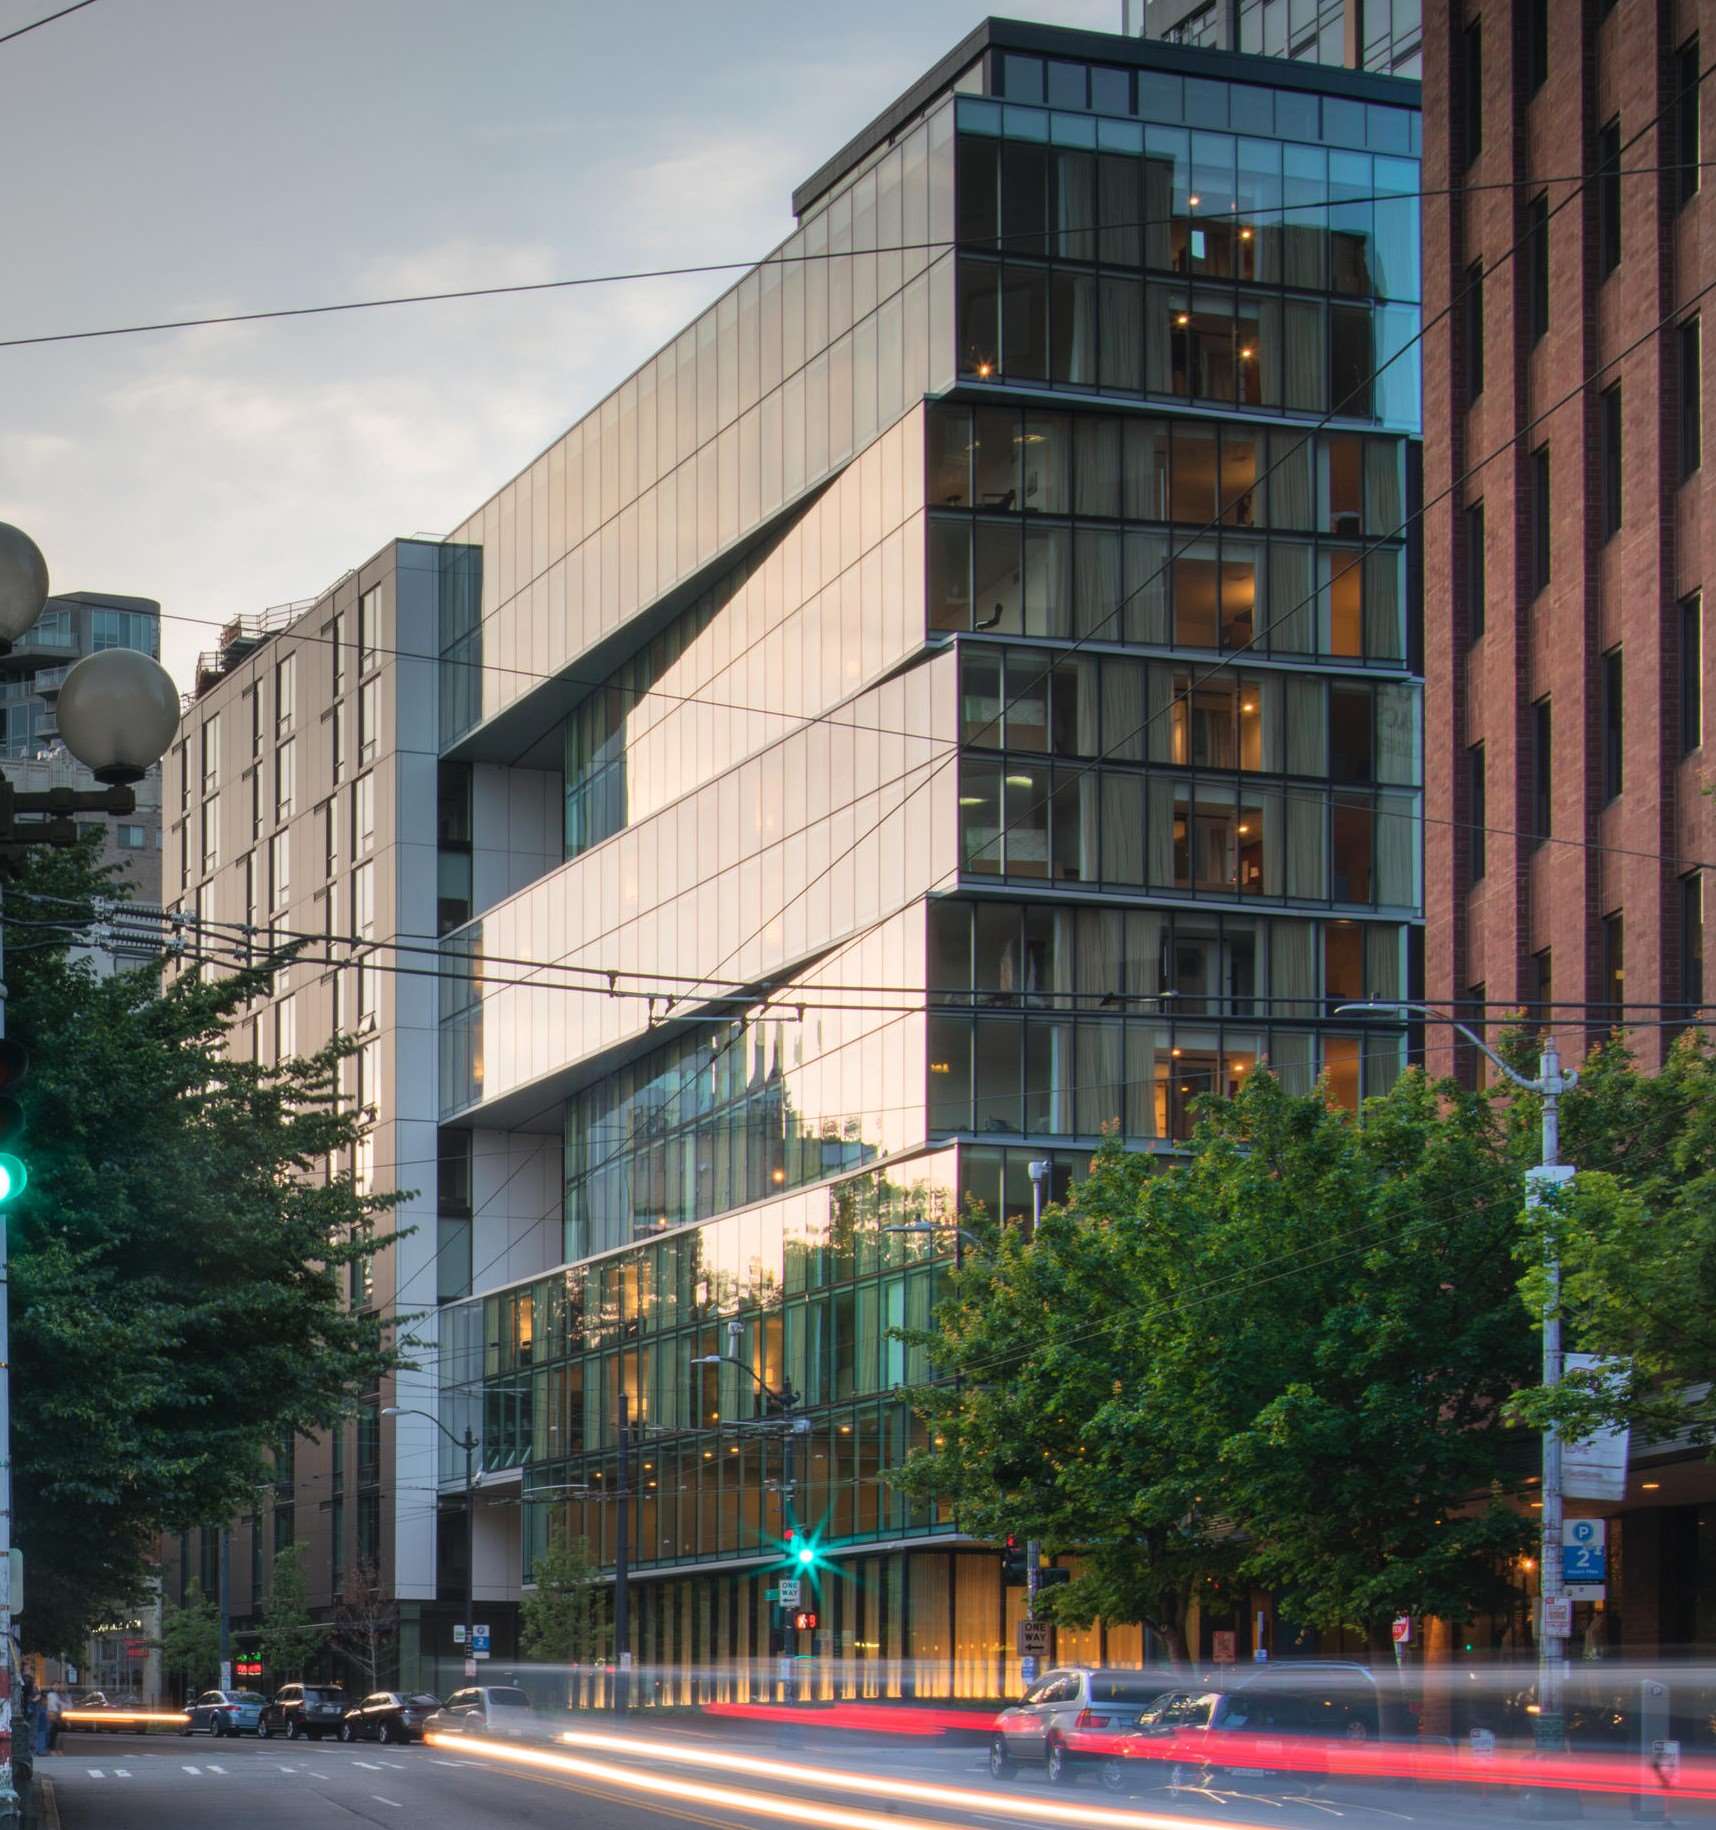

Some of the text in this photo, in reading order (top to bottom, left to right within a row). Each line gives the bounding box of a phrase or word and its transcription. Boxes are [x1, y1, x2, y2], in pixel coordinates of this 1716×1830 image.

[1579, 1526, 1589, 1538] P
[1576, 1550, 1590, 1567] 2
[782, 1582, 798, 1590] ONE
[1024, 1622, 1047, 1632] ONE
[1024, 1632, 1047, 1641] WAY
